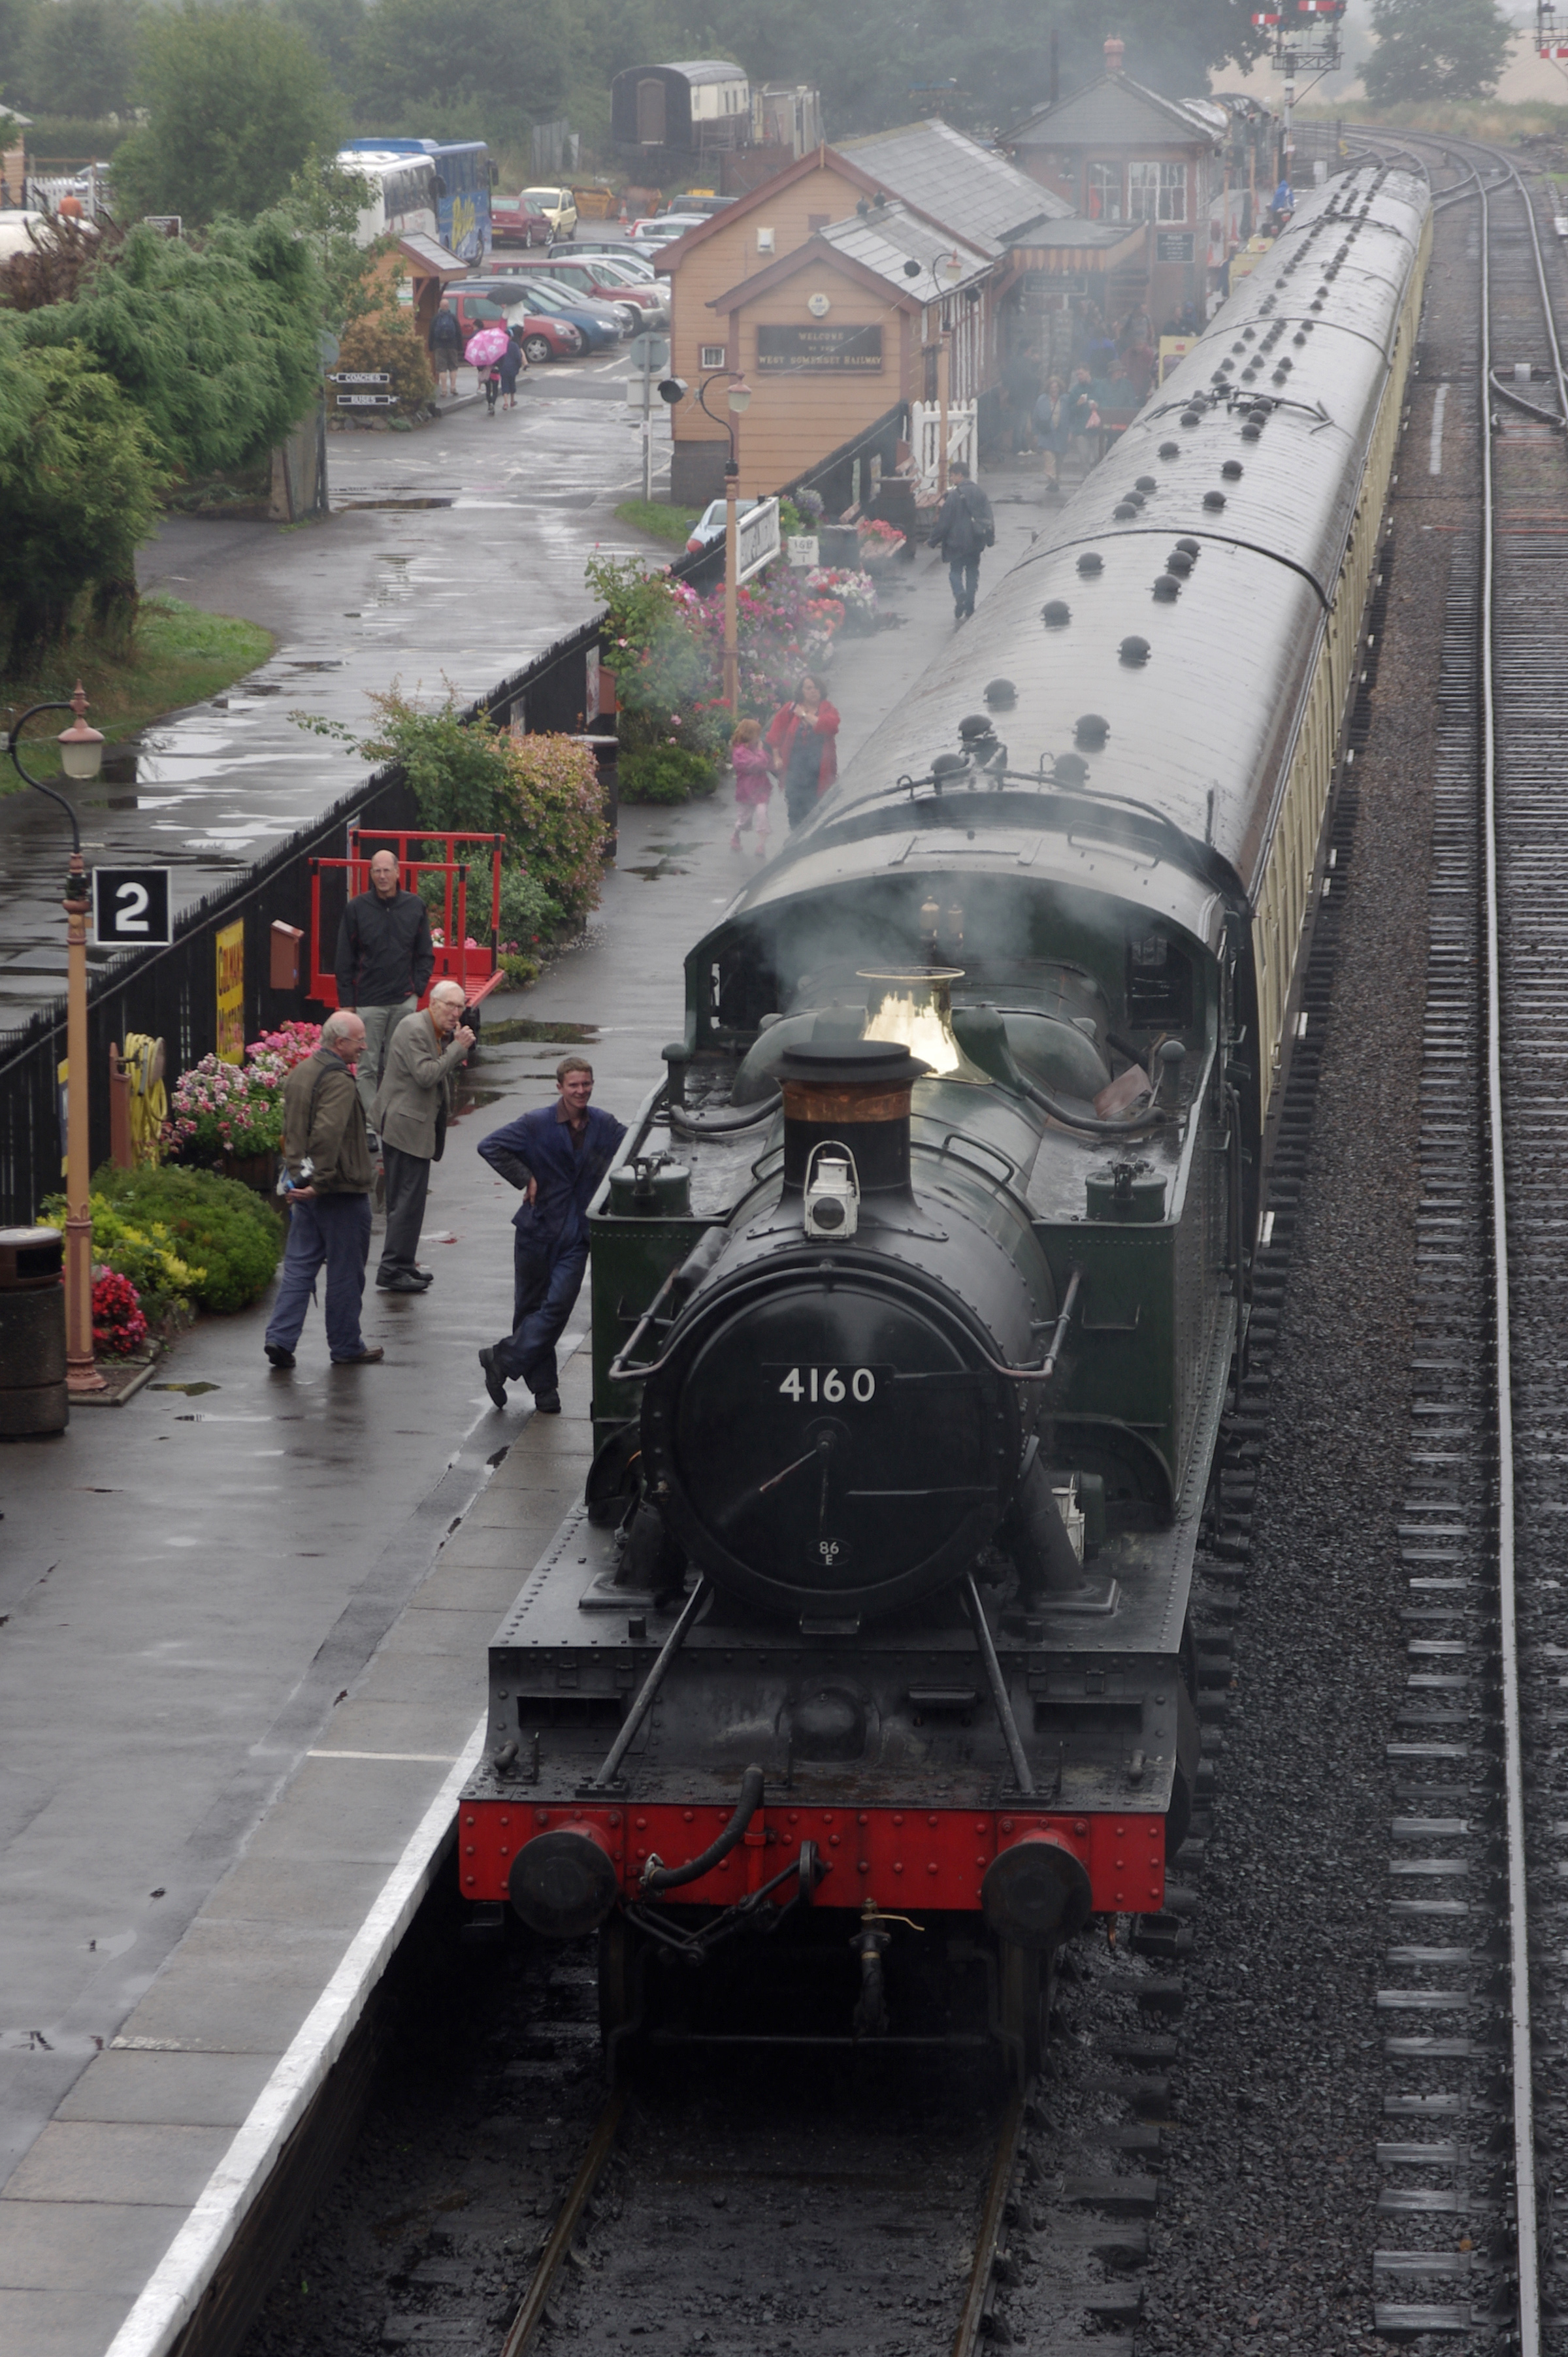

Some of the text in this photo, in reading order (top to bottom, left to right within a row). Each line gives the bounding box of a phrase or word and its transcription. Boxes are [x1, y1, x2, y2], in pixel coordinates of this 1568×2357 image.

[798, 332, 844, 340] WELCOME
[759, 355, 882, 365] WEST SOMERSET RAILWAY
[346, 373, 380, 382] COACHES
[116, 882, 149, 932] 2
[779, 1367, 875, 1403] 4160
[819, 1541, 840, 1555] 86
[826, 1554, 833, 1565] E
